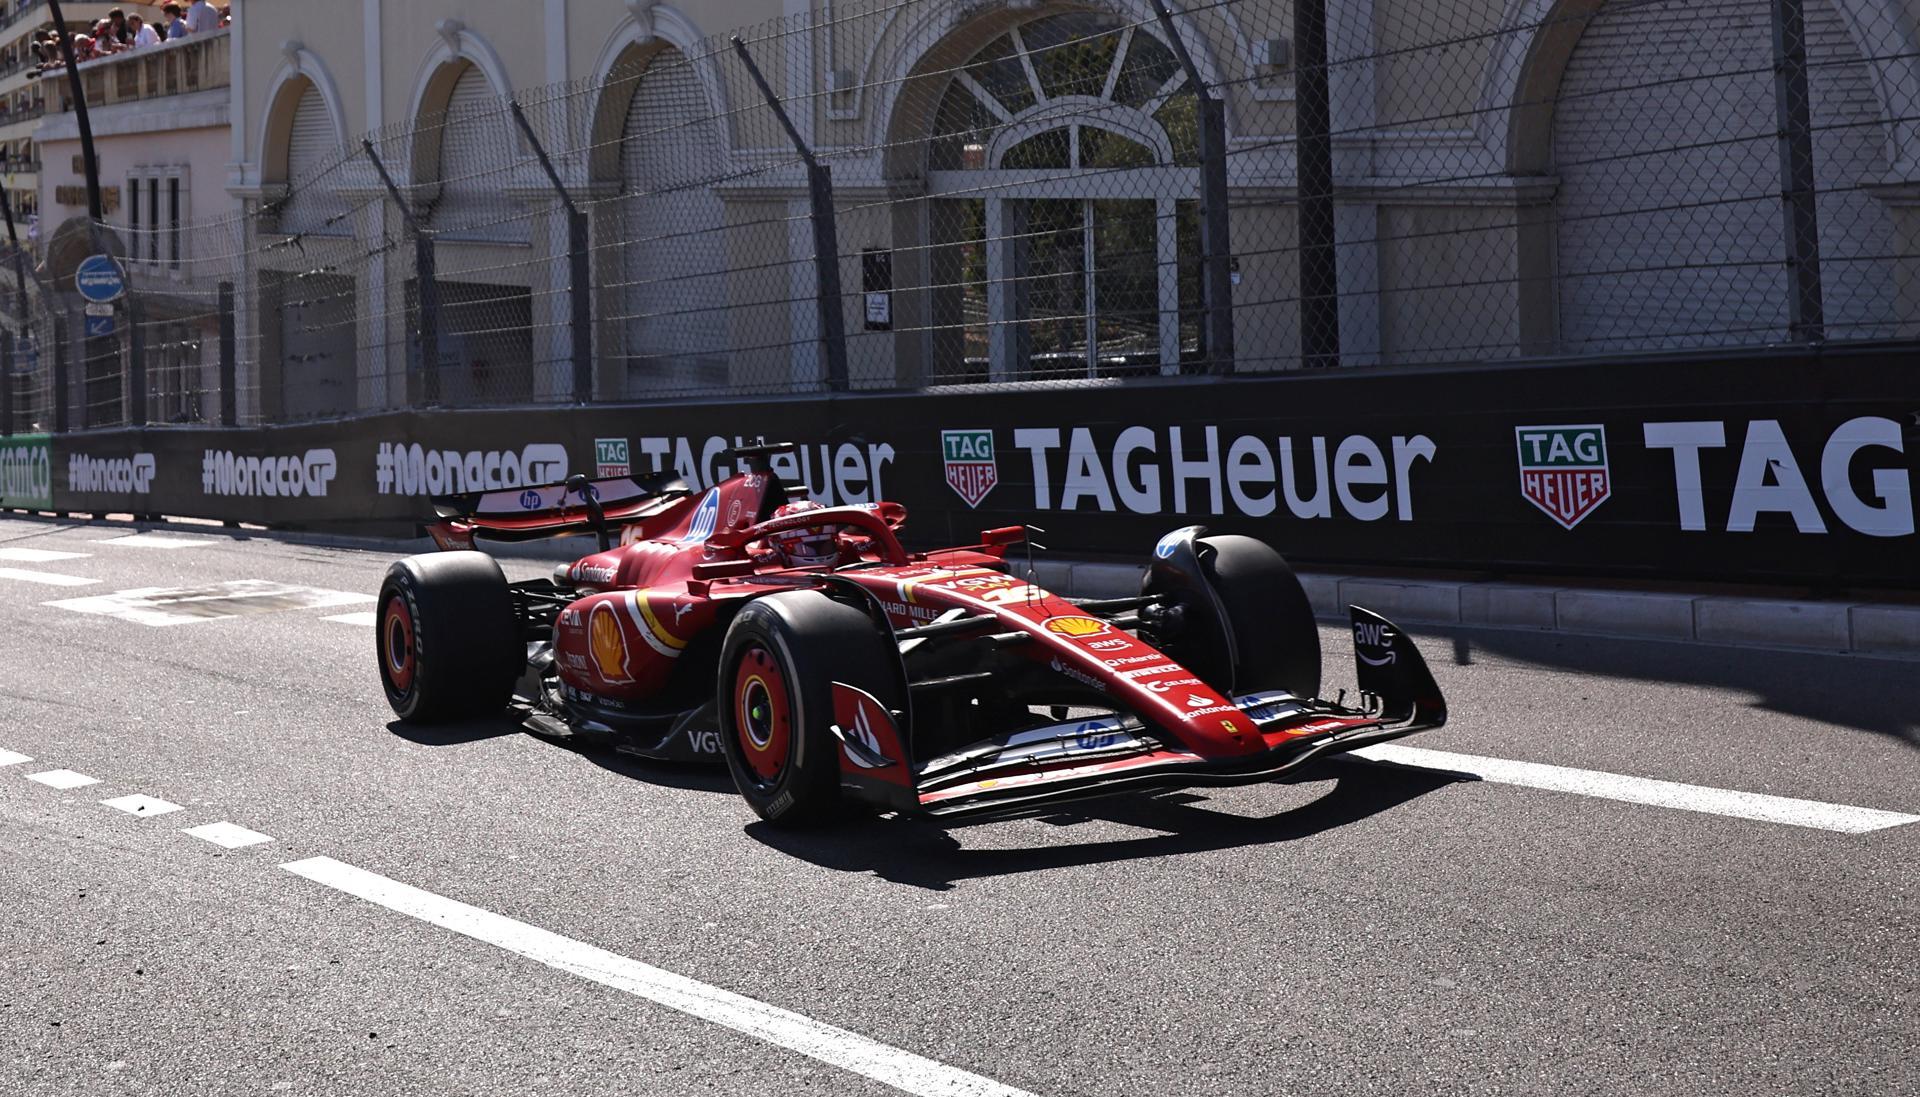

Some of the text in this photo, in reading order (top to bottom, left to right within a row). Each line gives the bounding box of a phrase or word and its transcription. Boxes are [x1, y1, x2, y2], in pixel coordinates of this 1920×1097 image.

[597, 443, 626, 461] TAG
[945, 435, 990, 457] TAG
[1523, 432, 1599, 463] TAG
[68, 452, 156, 494] #MonacoGP
[202, 448, 337, 497] #MonacoGP
[948, 463, 995, 502] HEUER
[1642, 415, 1915, 537] TAG
[1525, 472, 1605, 519] HEUER
[686, 488, 717, 541] hp
[981, 584, 1050, 607] 16
[908, 605, 938, 620] MILLE
[1088, 638, 1126, 650] aws
[1355, 622, 1393, 647] aws
